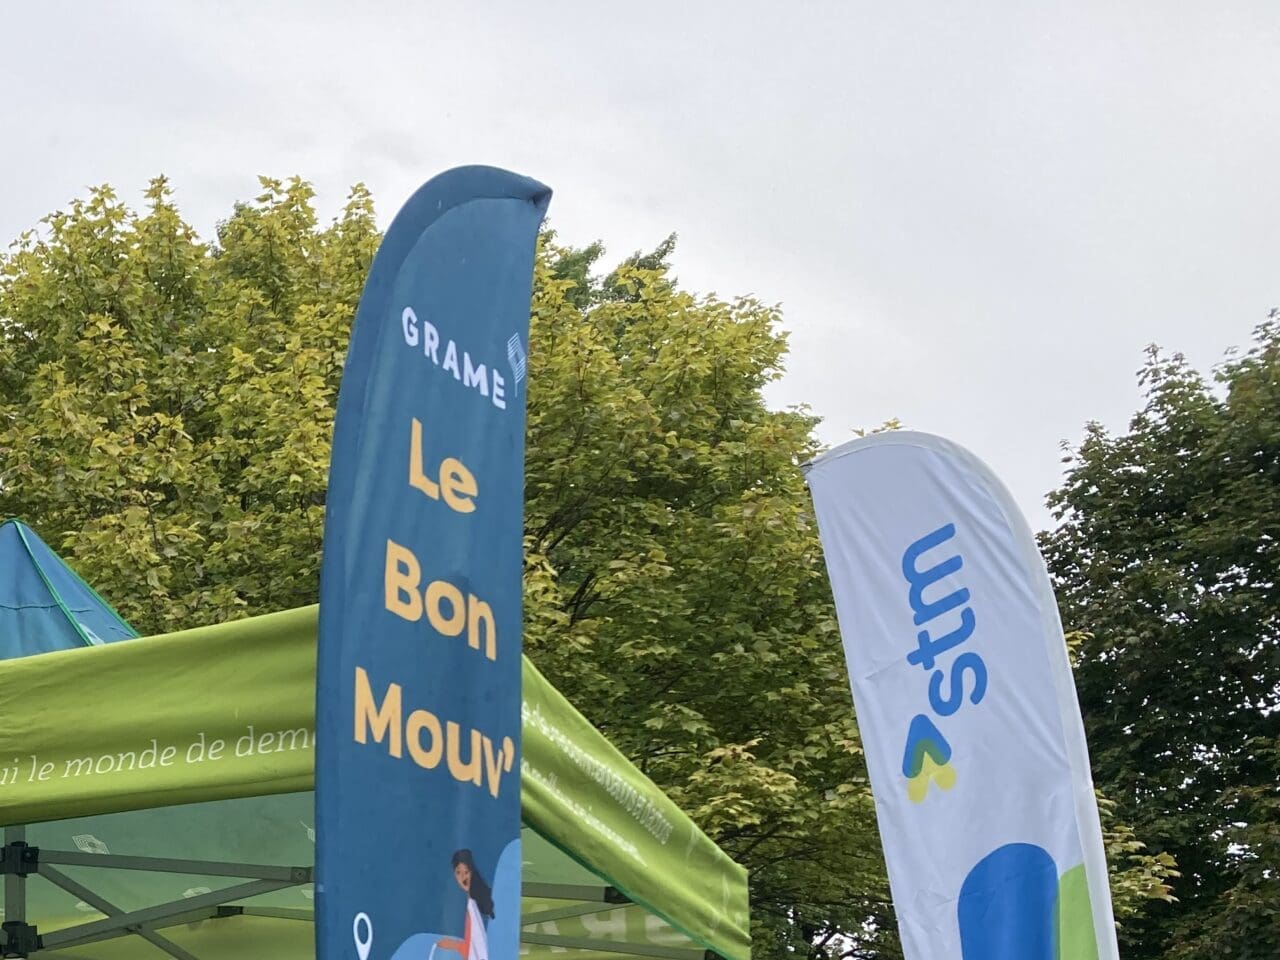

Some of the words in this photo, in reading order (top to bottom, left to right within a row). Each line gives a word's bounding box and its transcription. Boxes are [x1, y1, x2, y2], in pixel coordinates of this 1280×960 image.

[402, 306, 506, 410] GRAME
[408, 417, 479, 513] Le
[384, 538, 497, 661] Bon
[901, 522, 988, 717] stm
[28, 755, 55, 782] le
[61, 739, 177, 778] monde
[186, 732, 226, 764] de
[235, 725, 316, 757] dem
[353, 666, 515, 799] Mouv'
